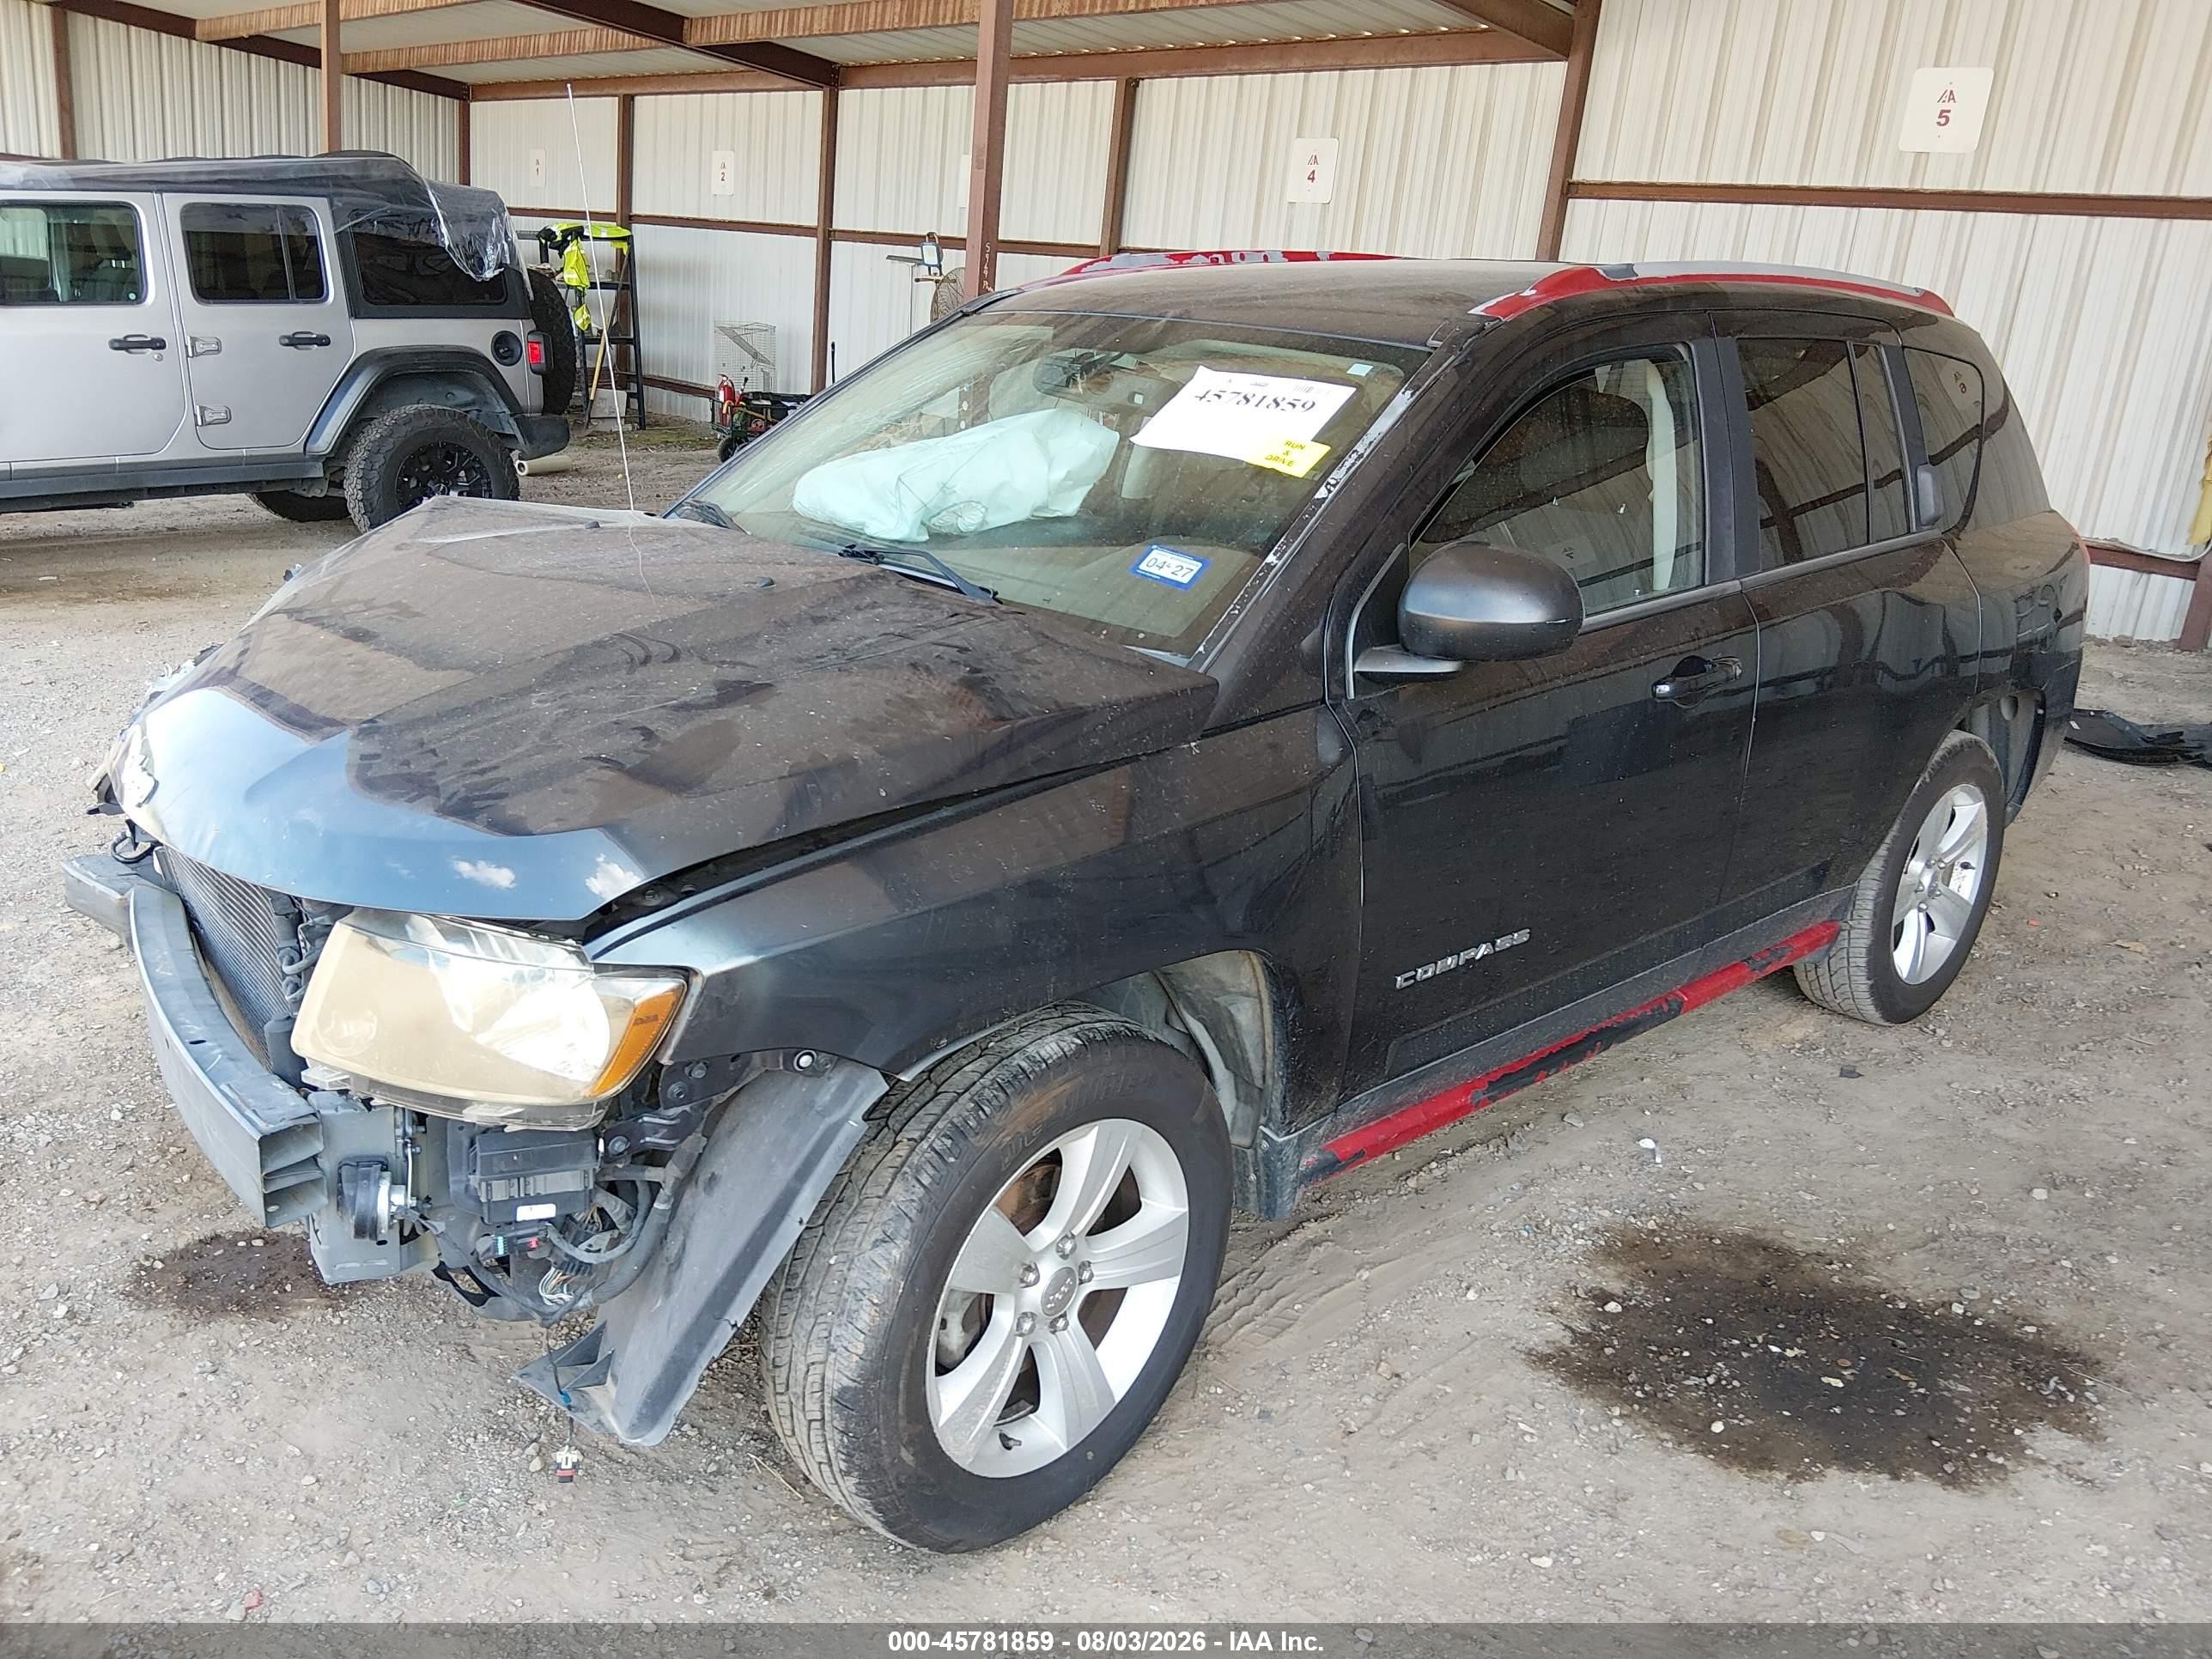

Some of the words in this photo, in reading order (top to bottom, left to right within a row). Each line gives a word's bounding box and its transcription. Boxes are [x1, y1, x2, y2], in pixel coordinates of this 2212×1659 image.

[1936, 109, 1951, 126] 5
[720, 171, 726, 182] 2
[1307, 168, 1316, 183] 4
[1194, 389, 1316, 413] 45781859
[1285, 441, 1306, 450] RUN
[1264, 454, 1295, 466] DRIVE
[1395, 928, 1531, 989] COMPASS
